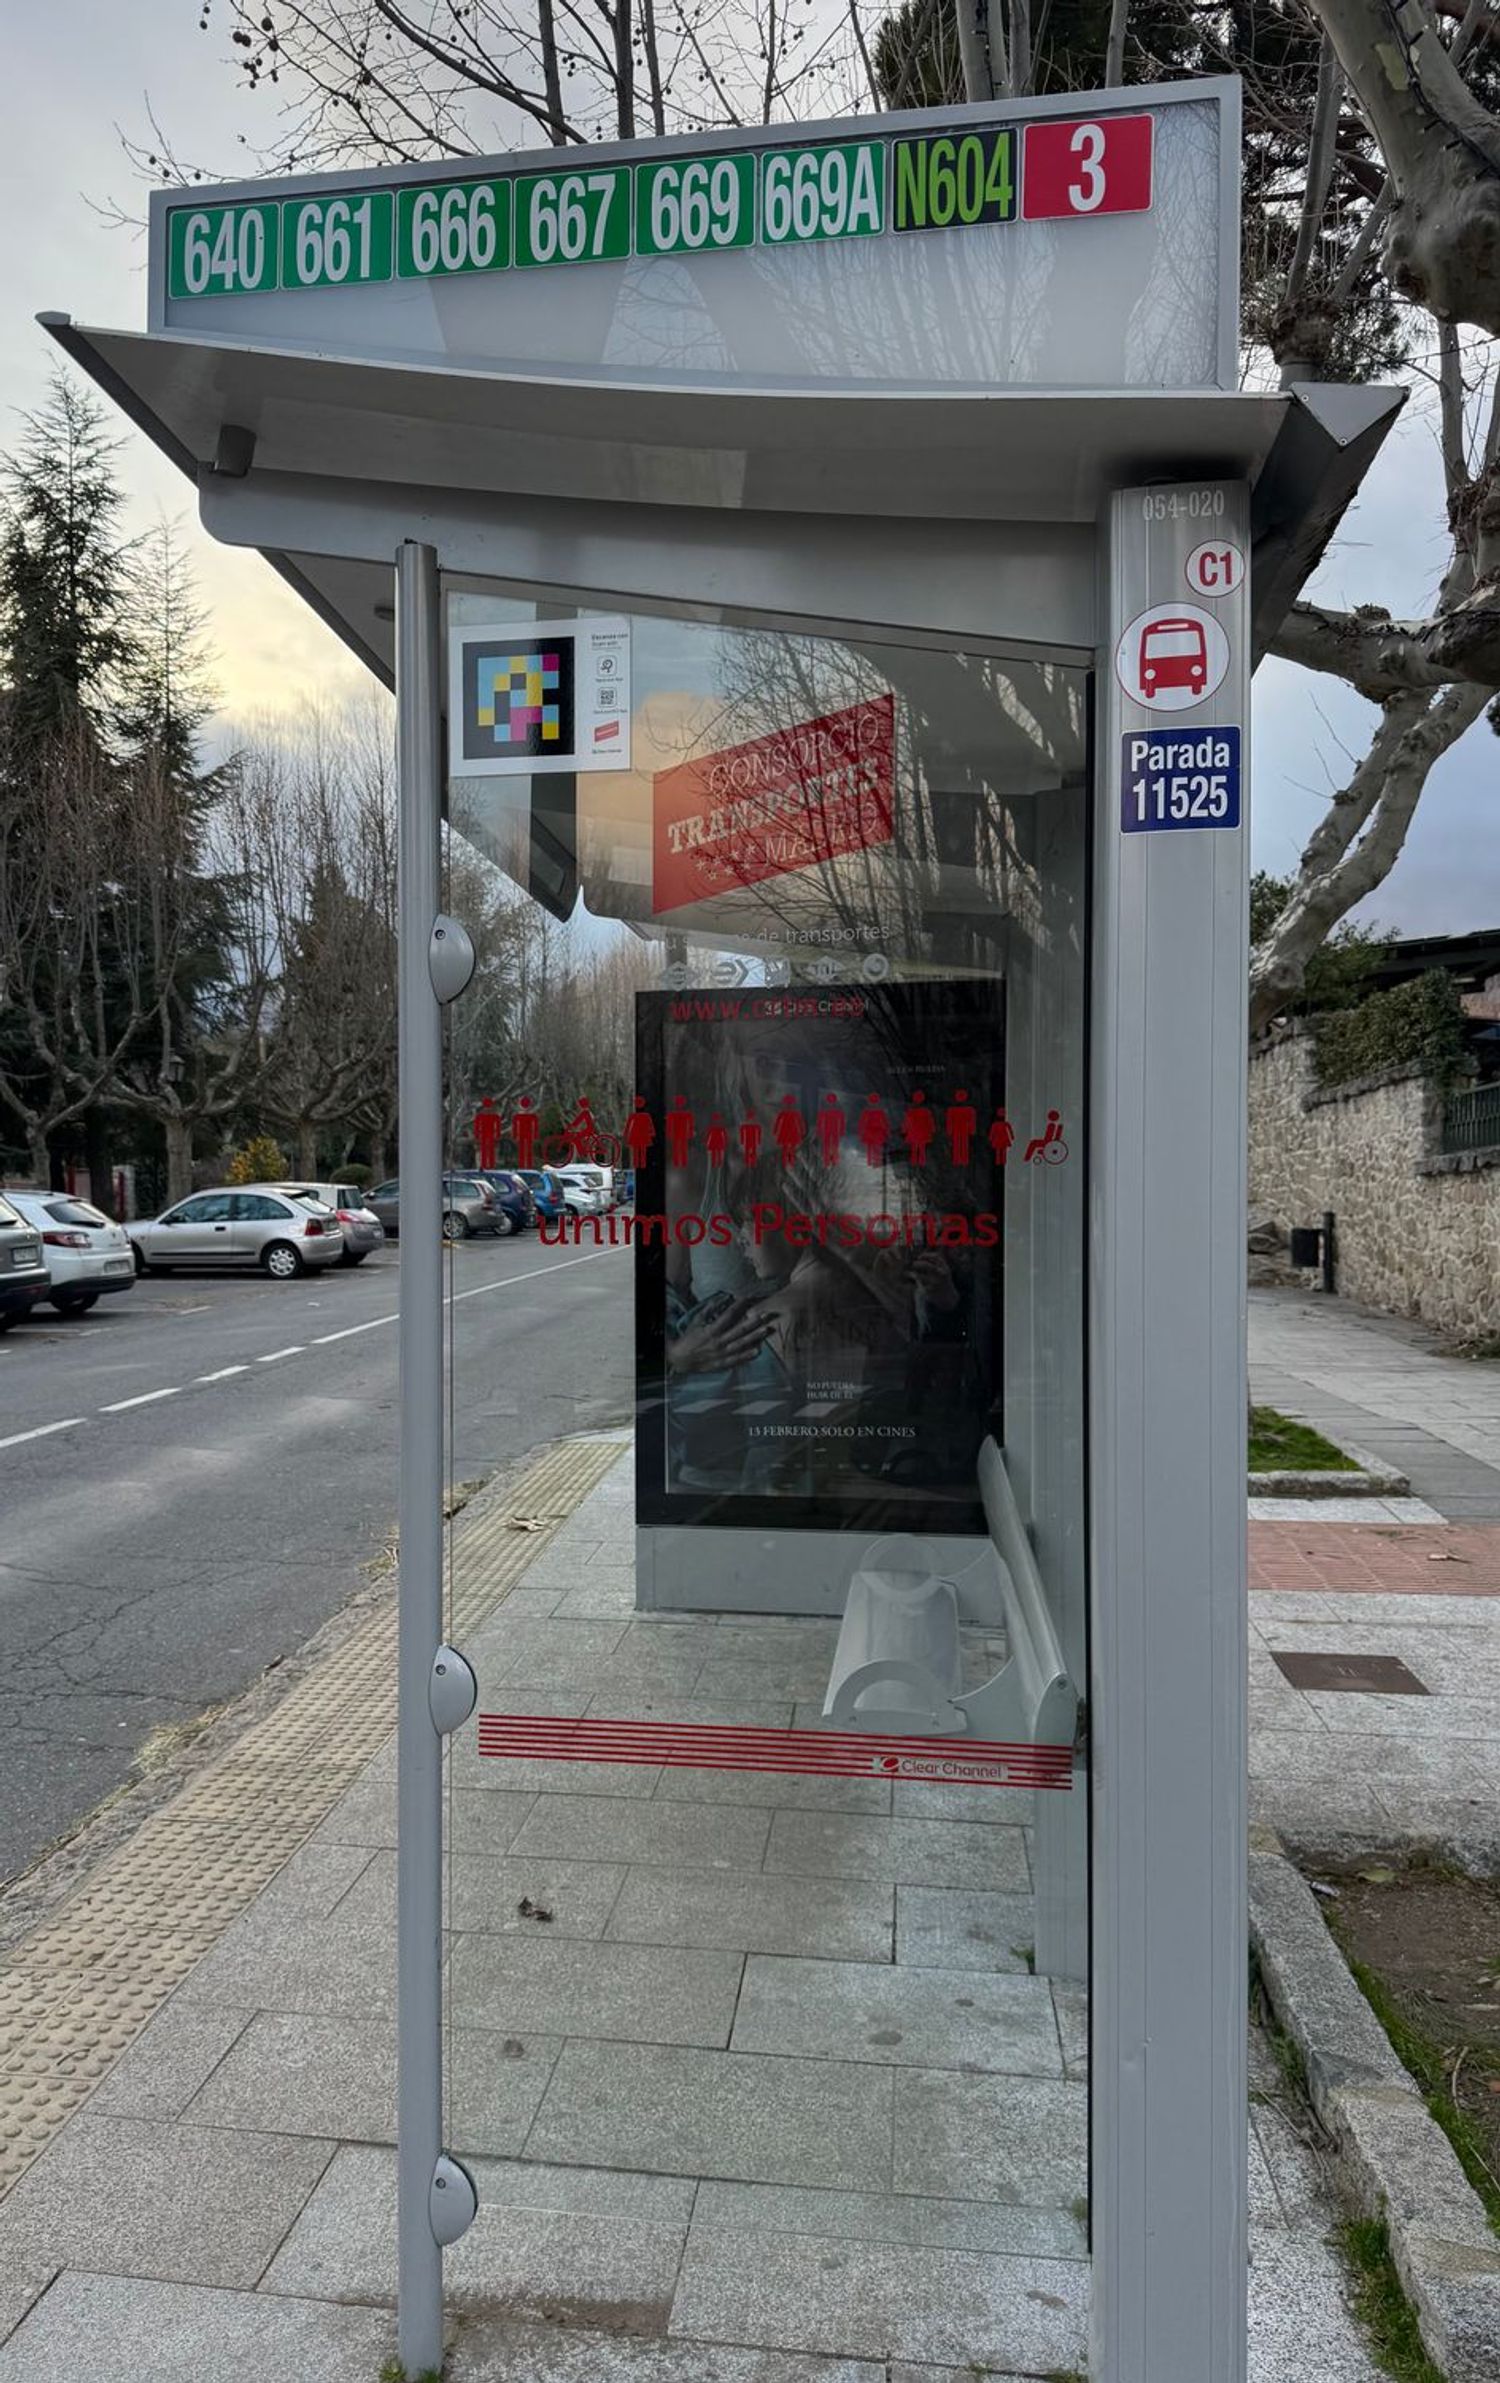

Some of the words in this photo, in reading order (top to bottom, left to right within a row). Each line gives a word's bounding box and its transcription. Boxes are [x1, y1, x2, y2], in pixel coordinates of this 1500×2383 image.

[184, 207, 266, 294] 640
[295, 197, 373, 284] 661
[411, 184, 497, 273] 666
[529, 172, 617, 263] 667
[650, 158, 741, 251] 669
[762, 145, 881, 242] 669A
[896, 131, 1013, 227] N604
[1068, 123, 1107, 214] 3
[1142, 488, 1226, 522] 054-020
[1199, 550, 1233, 588] C1
[709, 713, 880, 800] CONSORCIO
[1131, 736, 1230, 773] Parada
[1132, 775, 1229, 822] 11525
[785, 923, 890, 947] transportes
[537, 1204, 733, 1247] unimos
[751, 1202, 999, 1248] Personas
[763, 1426, 818, 1437] FEBRERO
[820, 1426, 855, 1437] SOLO
[857, 1427, 874, 1437] EN
[877, 1427, 916, 1438] CINES
[901, 1760, 939, 1774] Clear
[942, 1762, 1001, 1777] Channel
